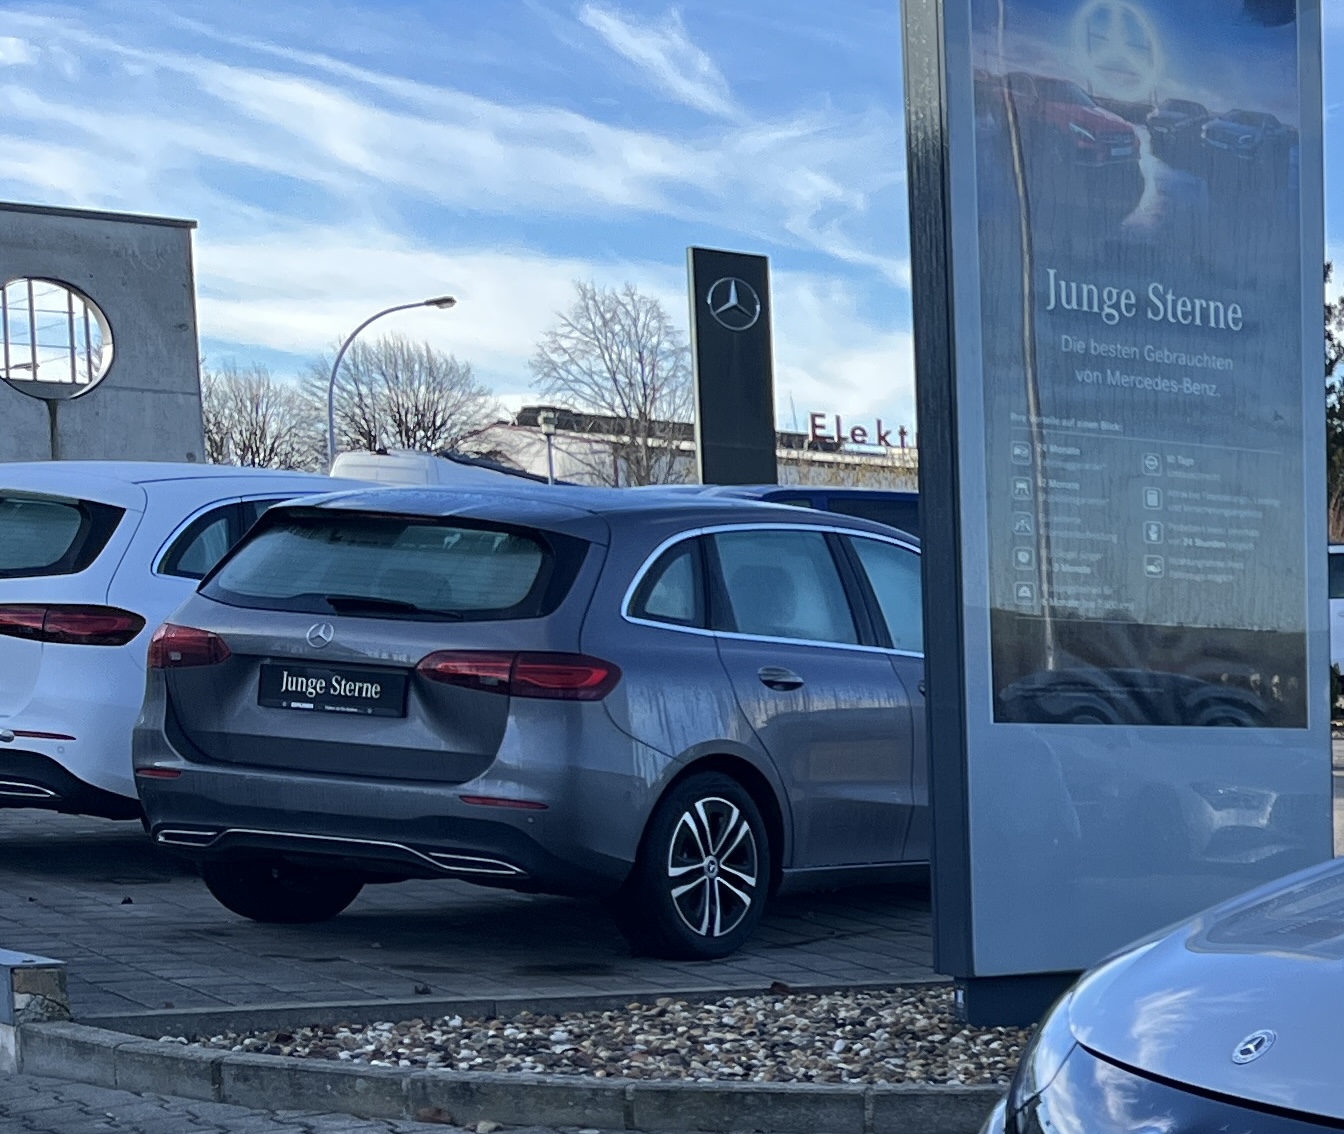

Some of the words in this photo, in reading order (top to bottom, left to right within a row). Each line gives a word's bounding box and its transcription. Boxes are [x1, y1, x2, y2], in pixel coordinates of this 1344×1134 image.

[1046, 268, 1136, 325] Junge
[1147, 282, 1243, 331] Sterne
[1061, 334, 1086, 354] Die
[1090, 338, 1140, 360] besten
[1143, 345, 1234, 371] Gebrauchten
[1075, 370, 1102, 384] von
[809, 411, 918, 449] Elekt
[281, 671, 326, 698] Junge
[330, 675, 381, 698] Sterne
